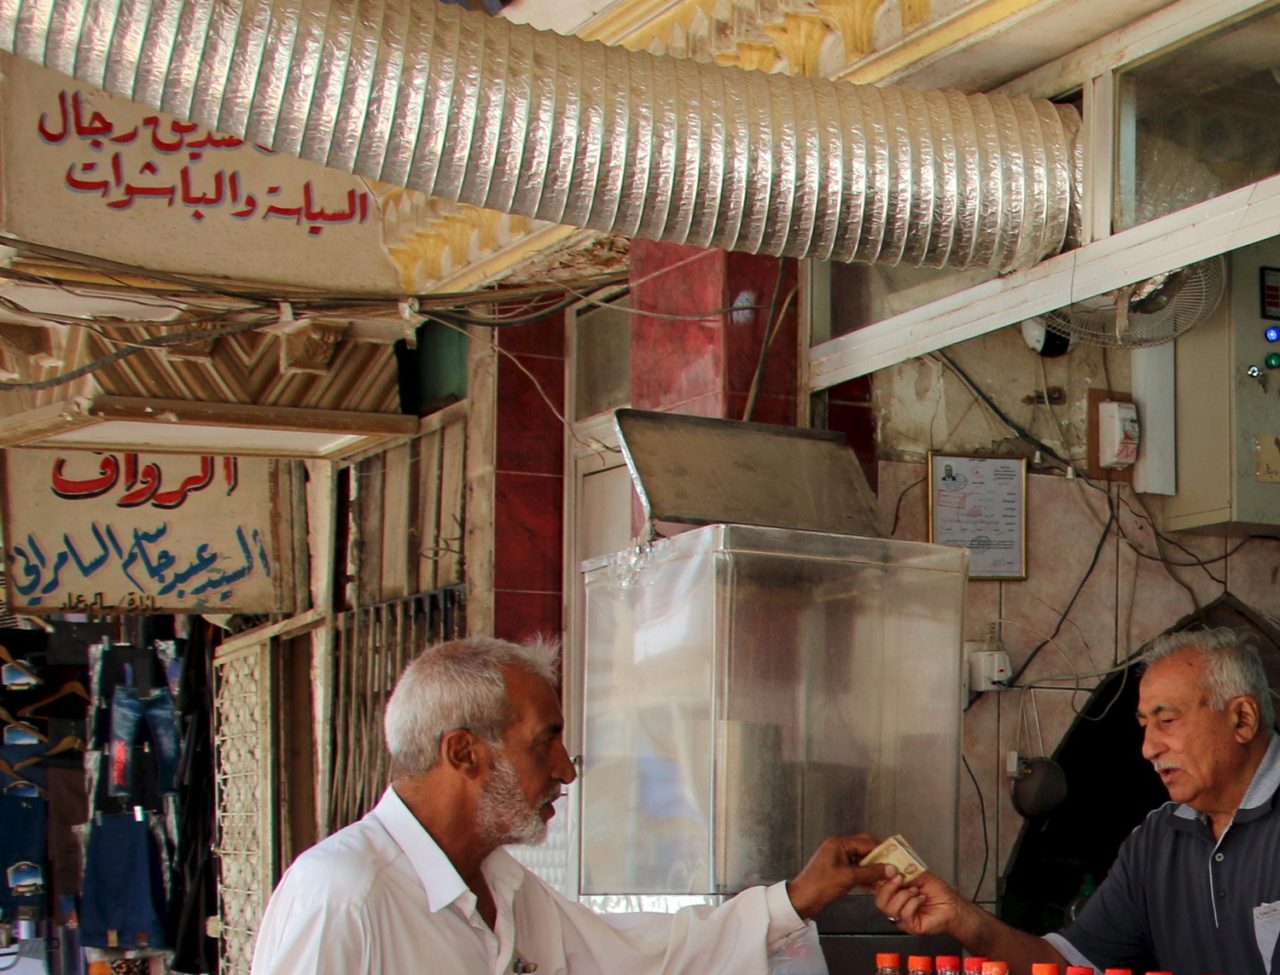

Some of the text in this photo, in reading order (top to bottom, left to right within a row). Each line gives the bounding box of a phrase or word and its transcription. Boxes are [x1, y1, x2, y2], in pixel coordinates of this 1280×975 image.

[38, 90, 138, 148] رجال
[65, 152, 368, 235] السياسة والباشوات
[190, 525, 272, 601] السيد
